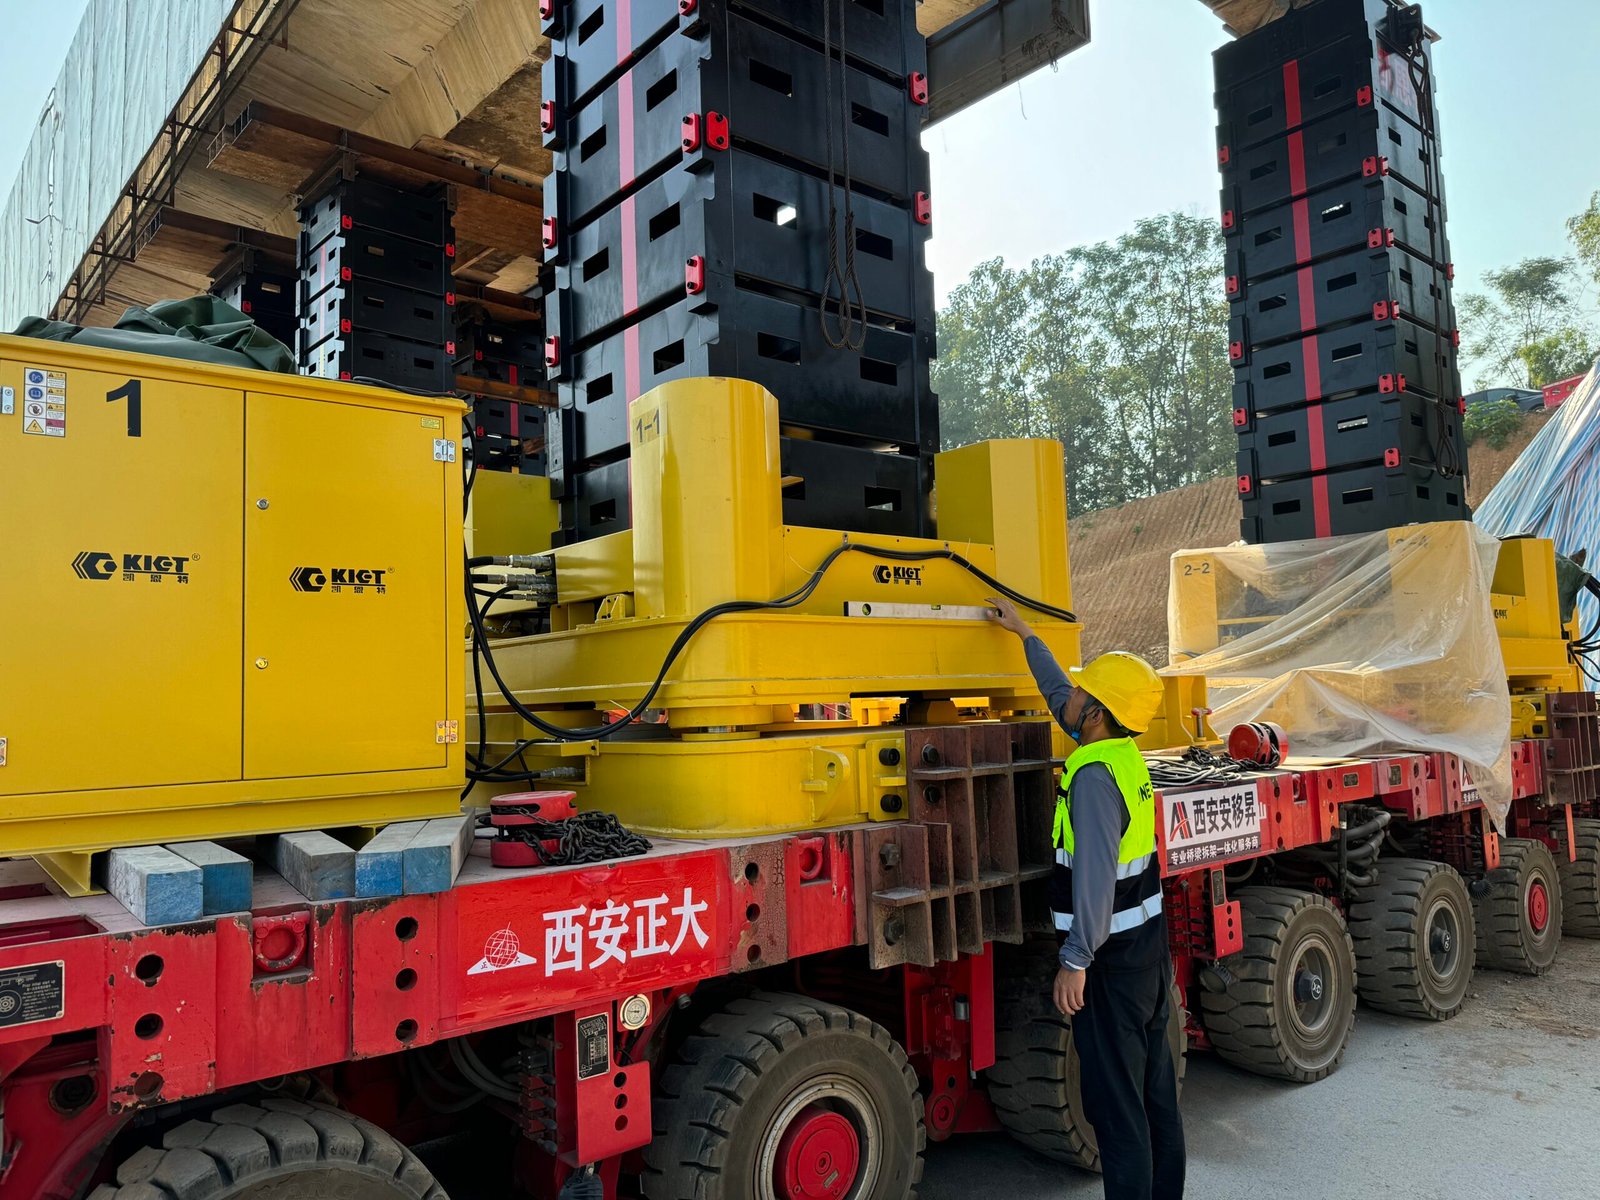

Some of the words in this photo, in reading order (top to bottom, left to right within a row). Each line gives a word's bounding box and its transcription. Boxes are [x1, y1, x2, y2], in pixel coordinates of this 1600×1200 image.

[106, 379, 141, 437] 1
[637, 409, 660, 442] 1-1
[1184, 562, 1210, 576] 2-2
[1193, 791, 1256, 834] 西安安移昇
[543, 887, 709, 977] 西安正大
